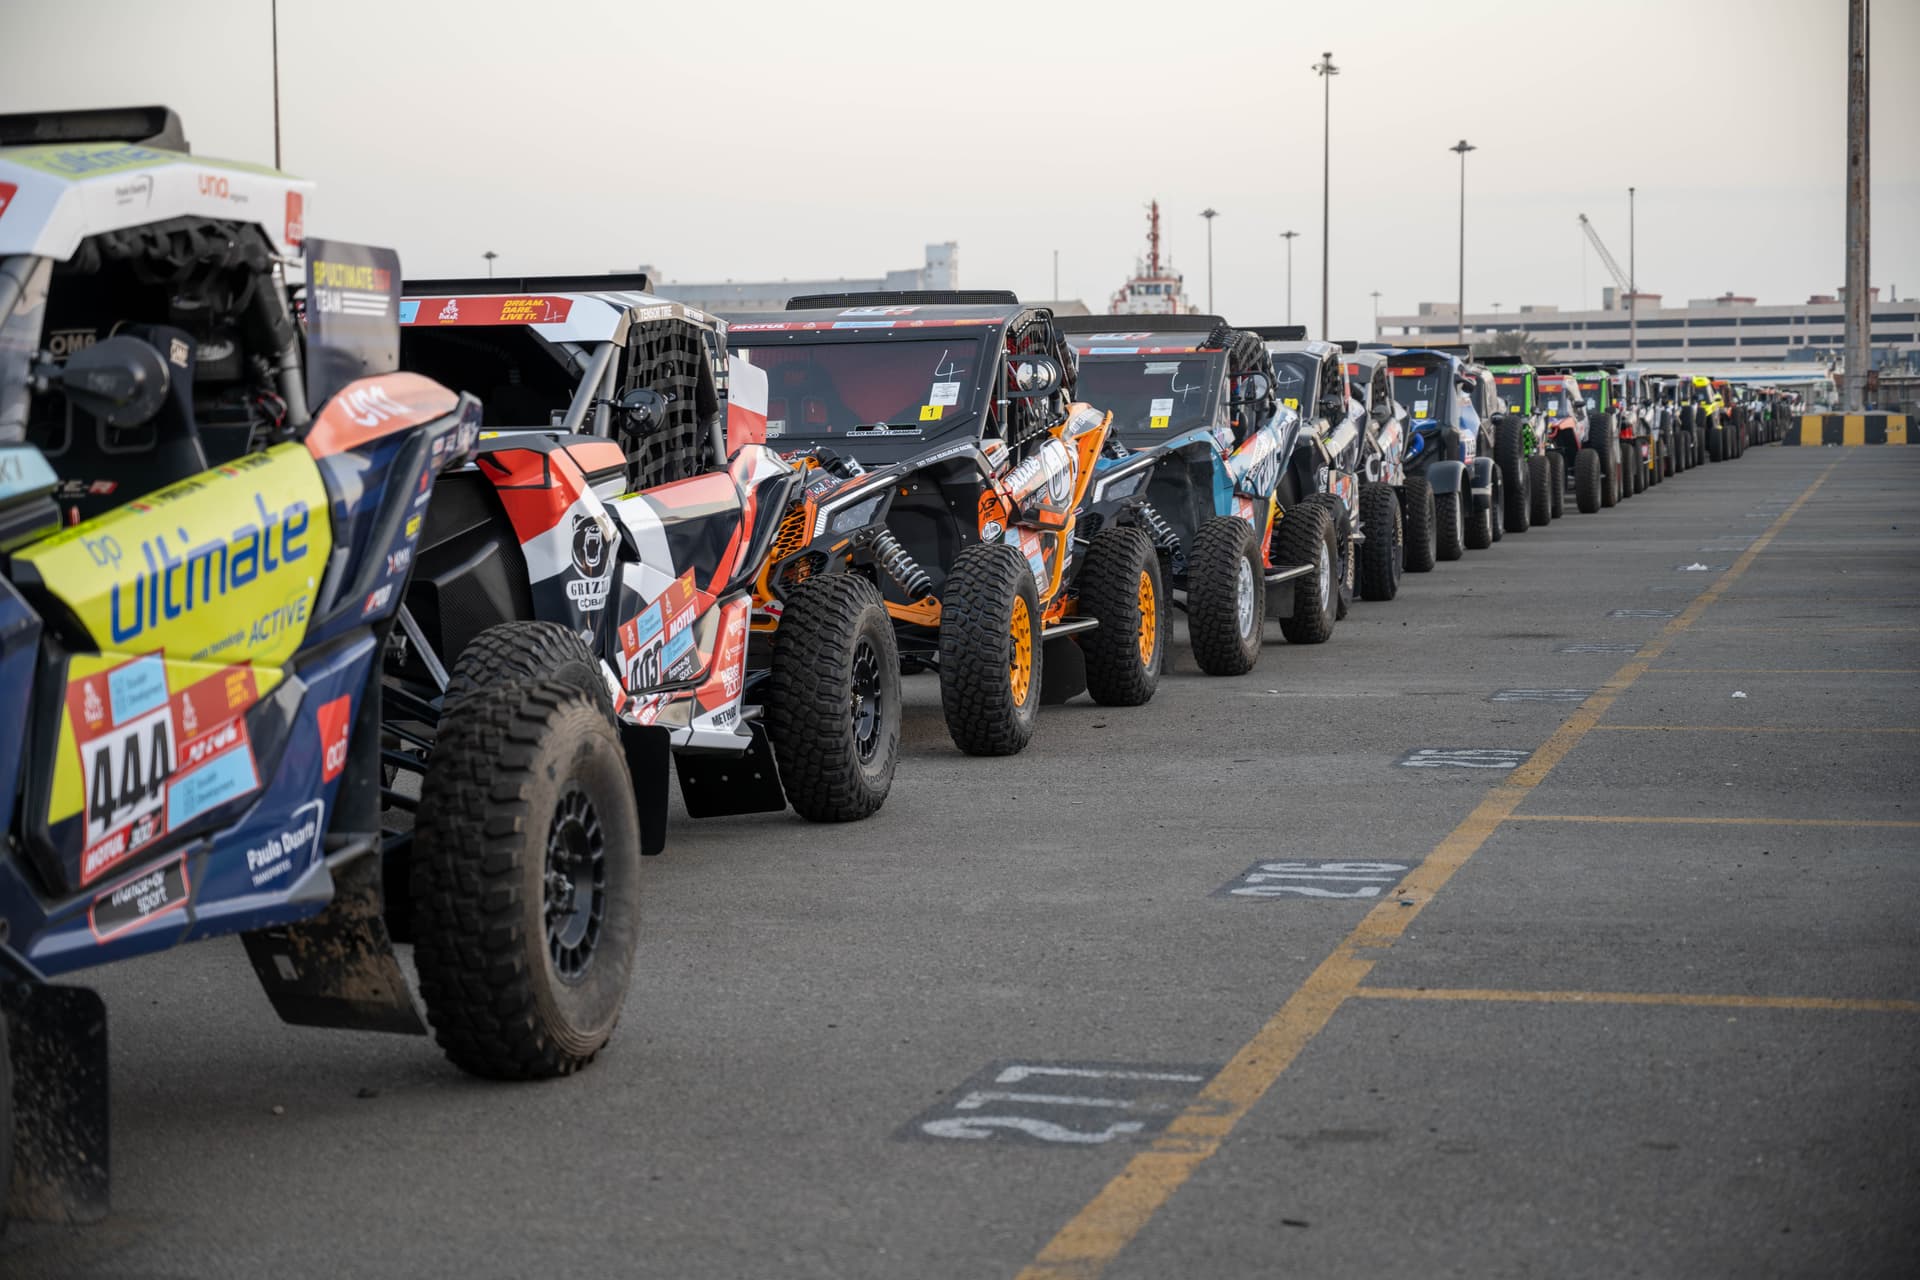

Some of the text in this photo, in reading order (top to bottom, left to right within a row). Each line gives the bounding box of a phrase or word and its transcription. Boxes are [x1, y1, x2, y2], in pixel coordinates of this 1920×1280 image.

[500, 313, 522, 321] LIVE
[504, 299, 544, 307] DREAM.
[935, 349, 966, 384] 4
[1171, 371, 1201, 402] 4
[249, 595, 307, 646] ACTIVE
[670, 604, 696, 639] MOTUL
[90, 719, 176, 831] 444
[247, 821, 316, 871] Paulo Duarte
